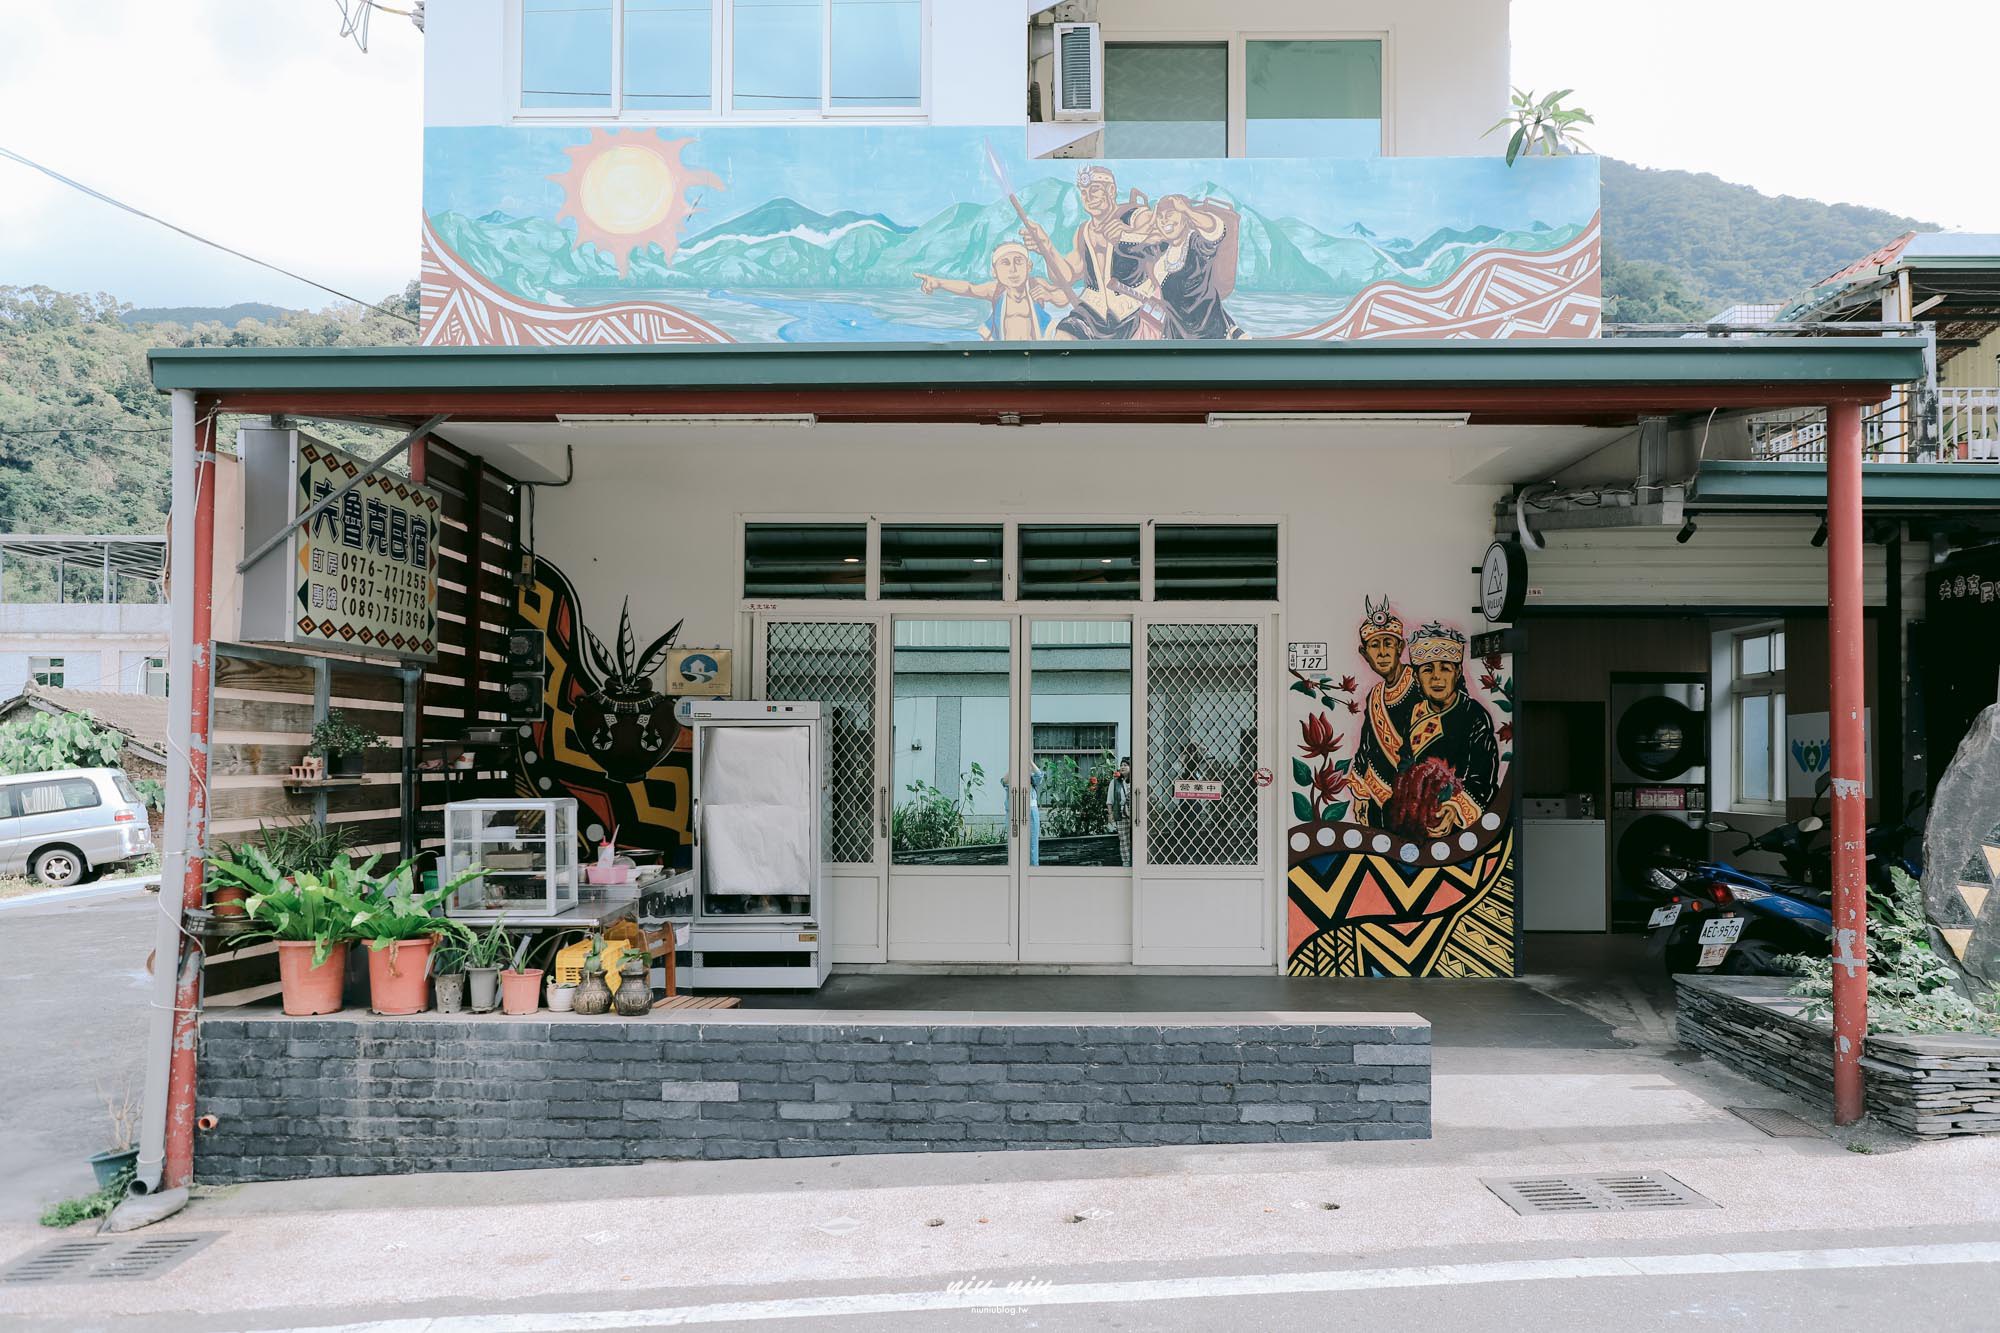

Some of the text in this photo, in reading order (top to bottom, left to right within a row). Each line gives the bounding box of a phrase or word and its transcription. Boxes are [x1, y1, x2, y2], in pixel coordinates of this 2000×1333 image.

[312, 477, 428, 570] 夫魯克民宿
[312, 547, 338, 576] 訂房
[341, 552, 426, 591] 0976-771255
[312, 583, 338, 610] 專線
[341, 574, 426, 610] 0937-497793
[341, 597, 425, 630] (089)751396
[1301, 657, 1322, 669] 127
[1180, 783, 1216, 792] 營業中
[1701, 925, 1740, 938] AEC-9579
